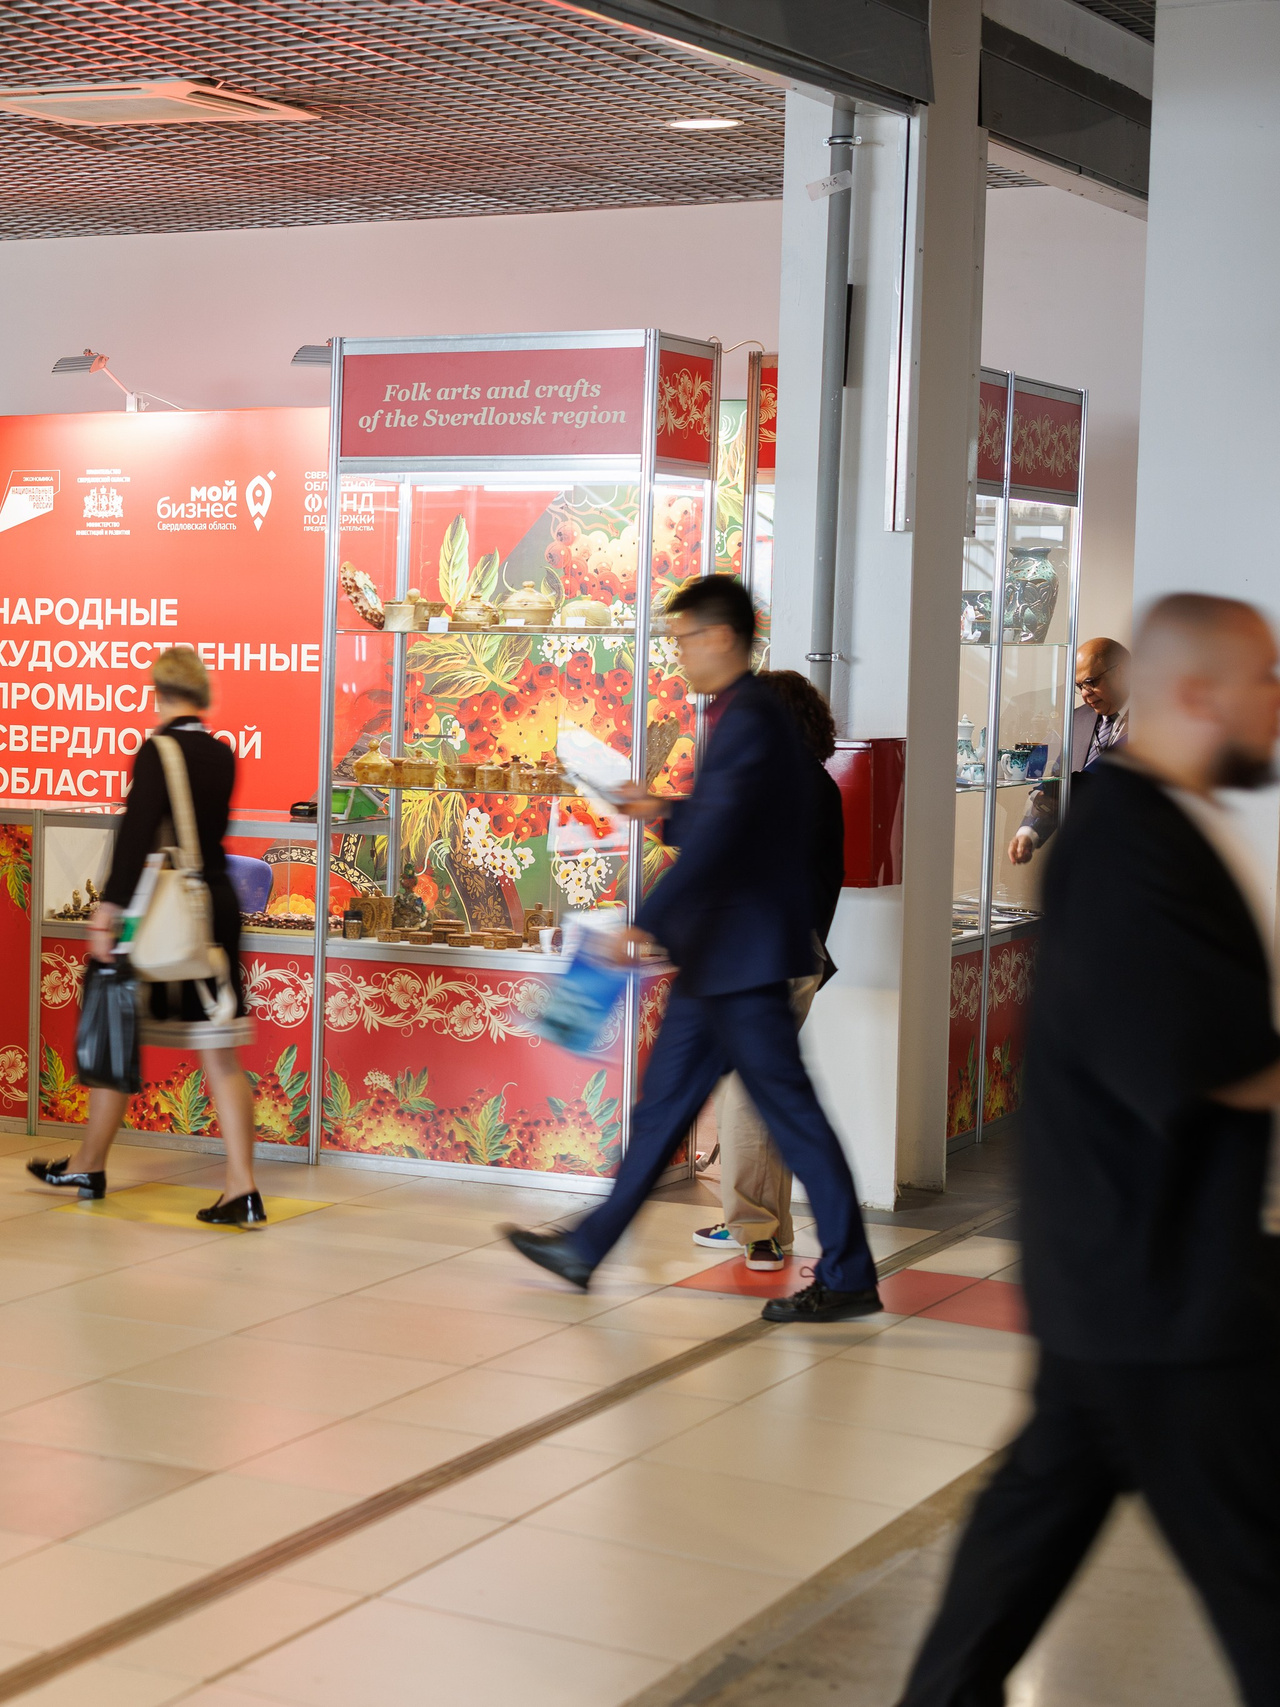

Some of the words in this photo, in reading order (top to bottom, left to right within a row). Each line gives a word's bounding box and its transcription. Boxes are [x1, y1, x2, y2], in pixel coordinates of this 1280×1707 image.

[382, 383, 432, 402] Folk
[436, 384, 481, 401] arts
[486, 380, 531, 400] and
[534, 378, 602, 402] crafts
[358, 409, 385, 432] of
[385, 409, 419, 428] the
[422, 406, 547, 427] Sverdlovsk
[551, 405, 627, 429] region
[190, 480, 237, 502] мой
[304, 479, 376, 491] ОБЛТНОЙ
[156, 496, 238, 519] бизнес
[304, 493, 375, 514] ФНД
[157, 521, 207, 533] Свердловская
[208, 521, 237, 531] область
[303, 514, 375, 525] ПОДРЖКИ
